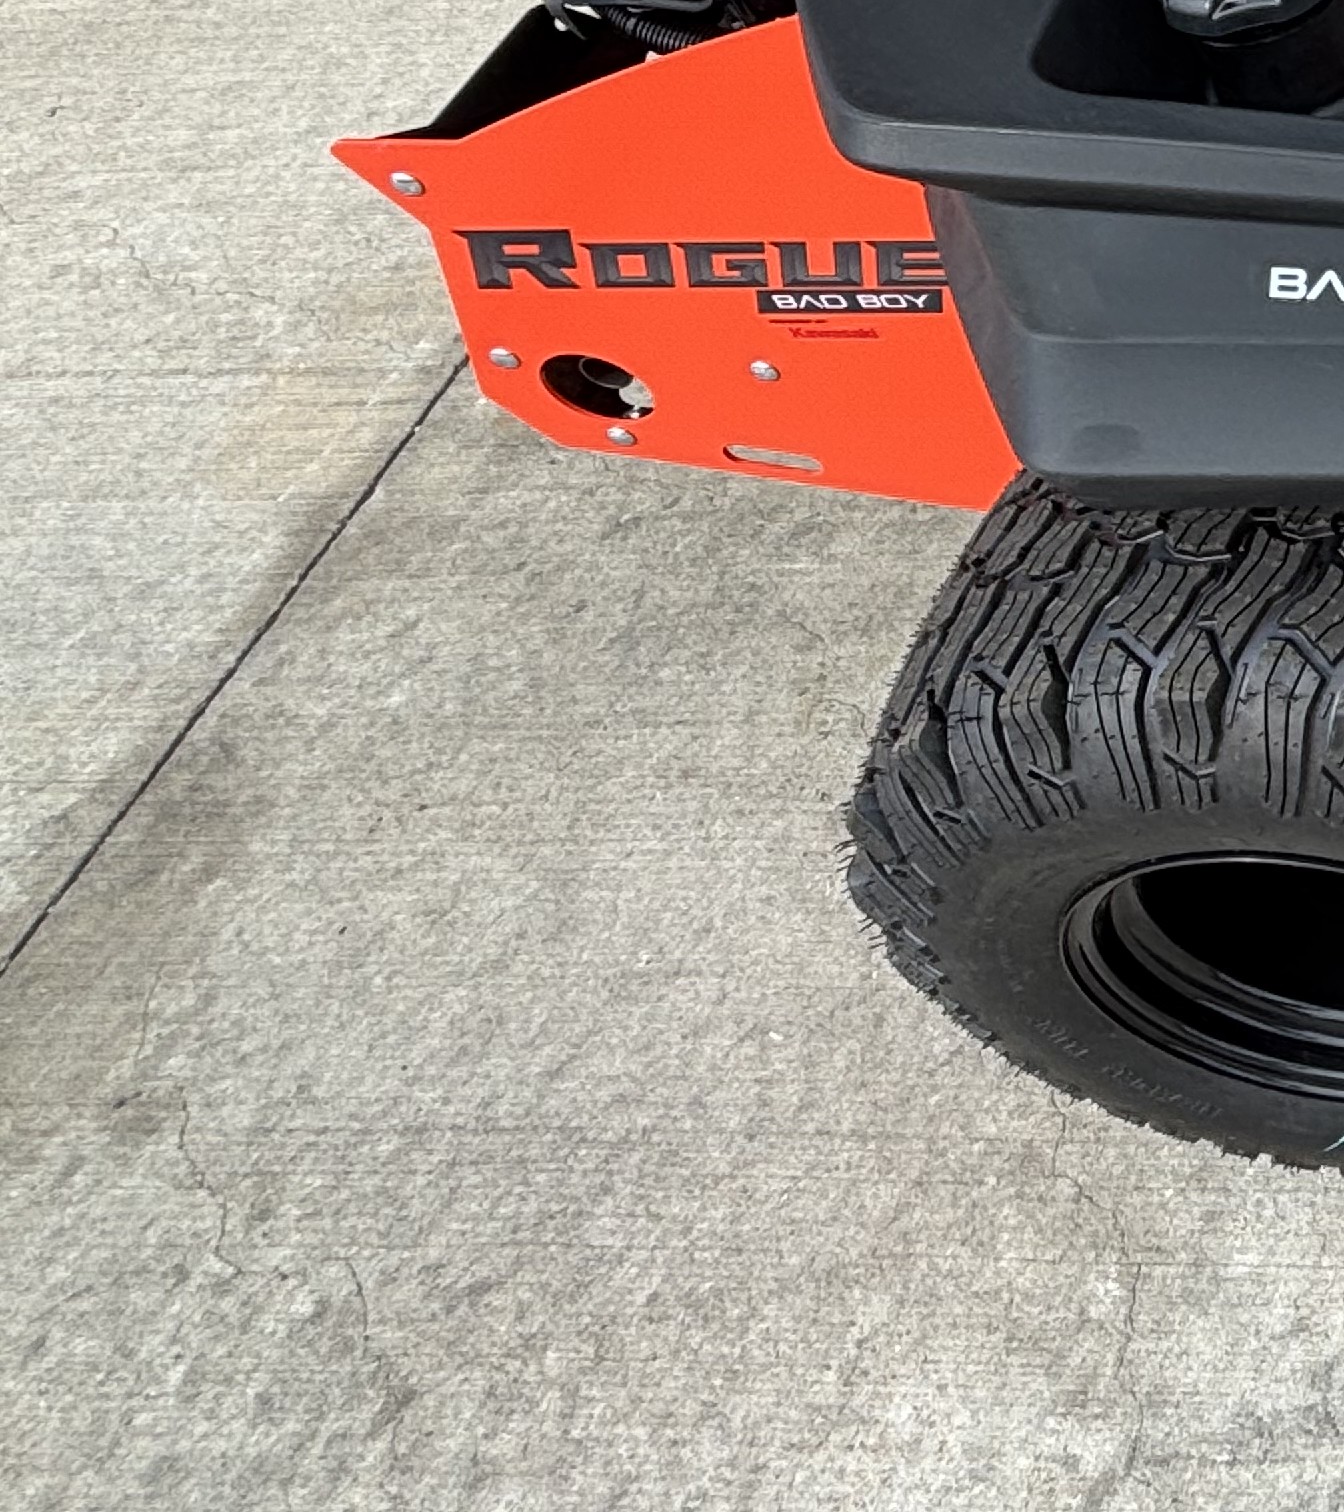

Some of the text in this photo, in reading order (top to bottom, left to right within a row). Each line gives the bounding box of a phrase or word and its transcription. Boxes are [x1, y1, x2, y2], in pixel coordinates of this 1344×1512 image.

[453, 228, 948, 290] ROGUE
[771, 294, 929, 309] BAD BOY
